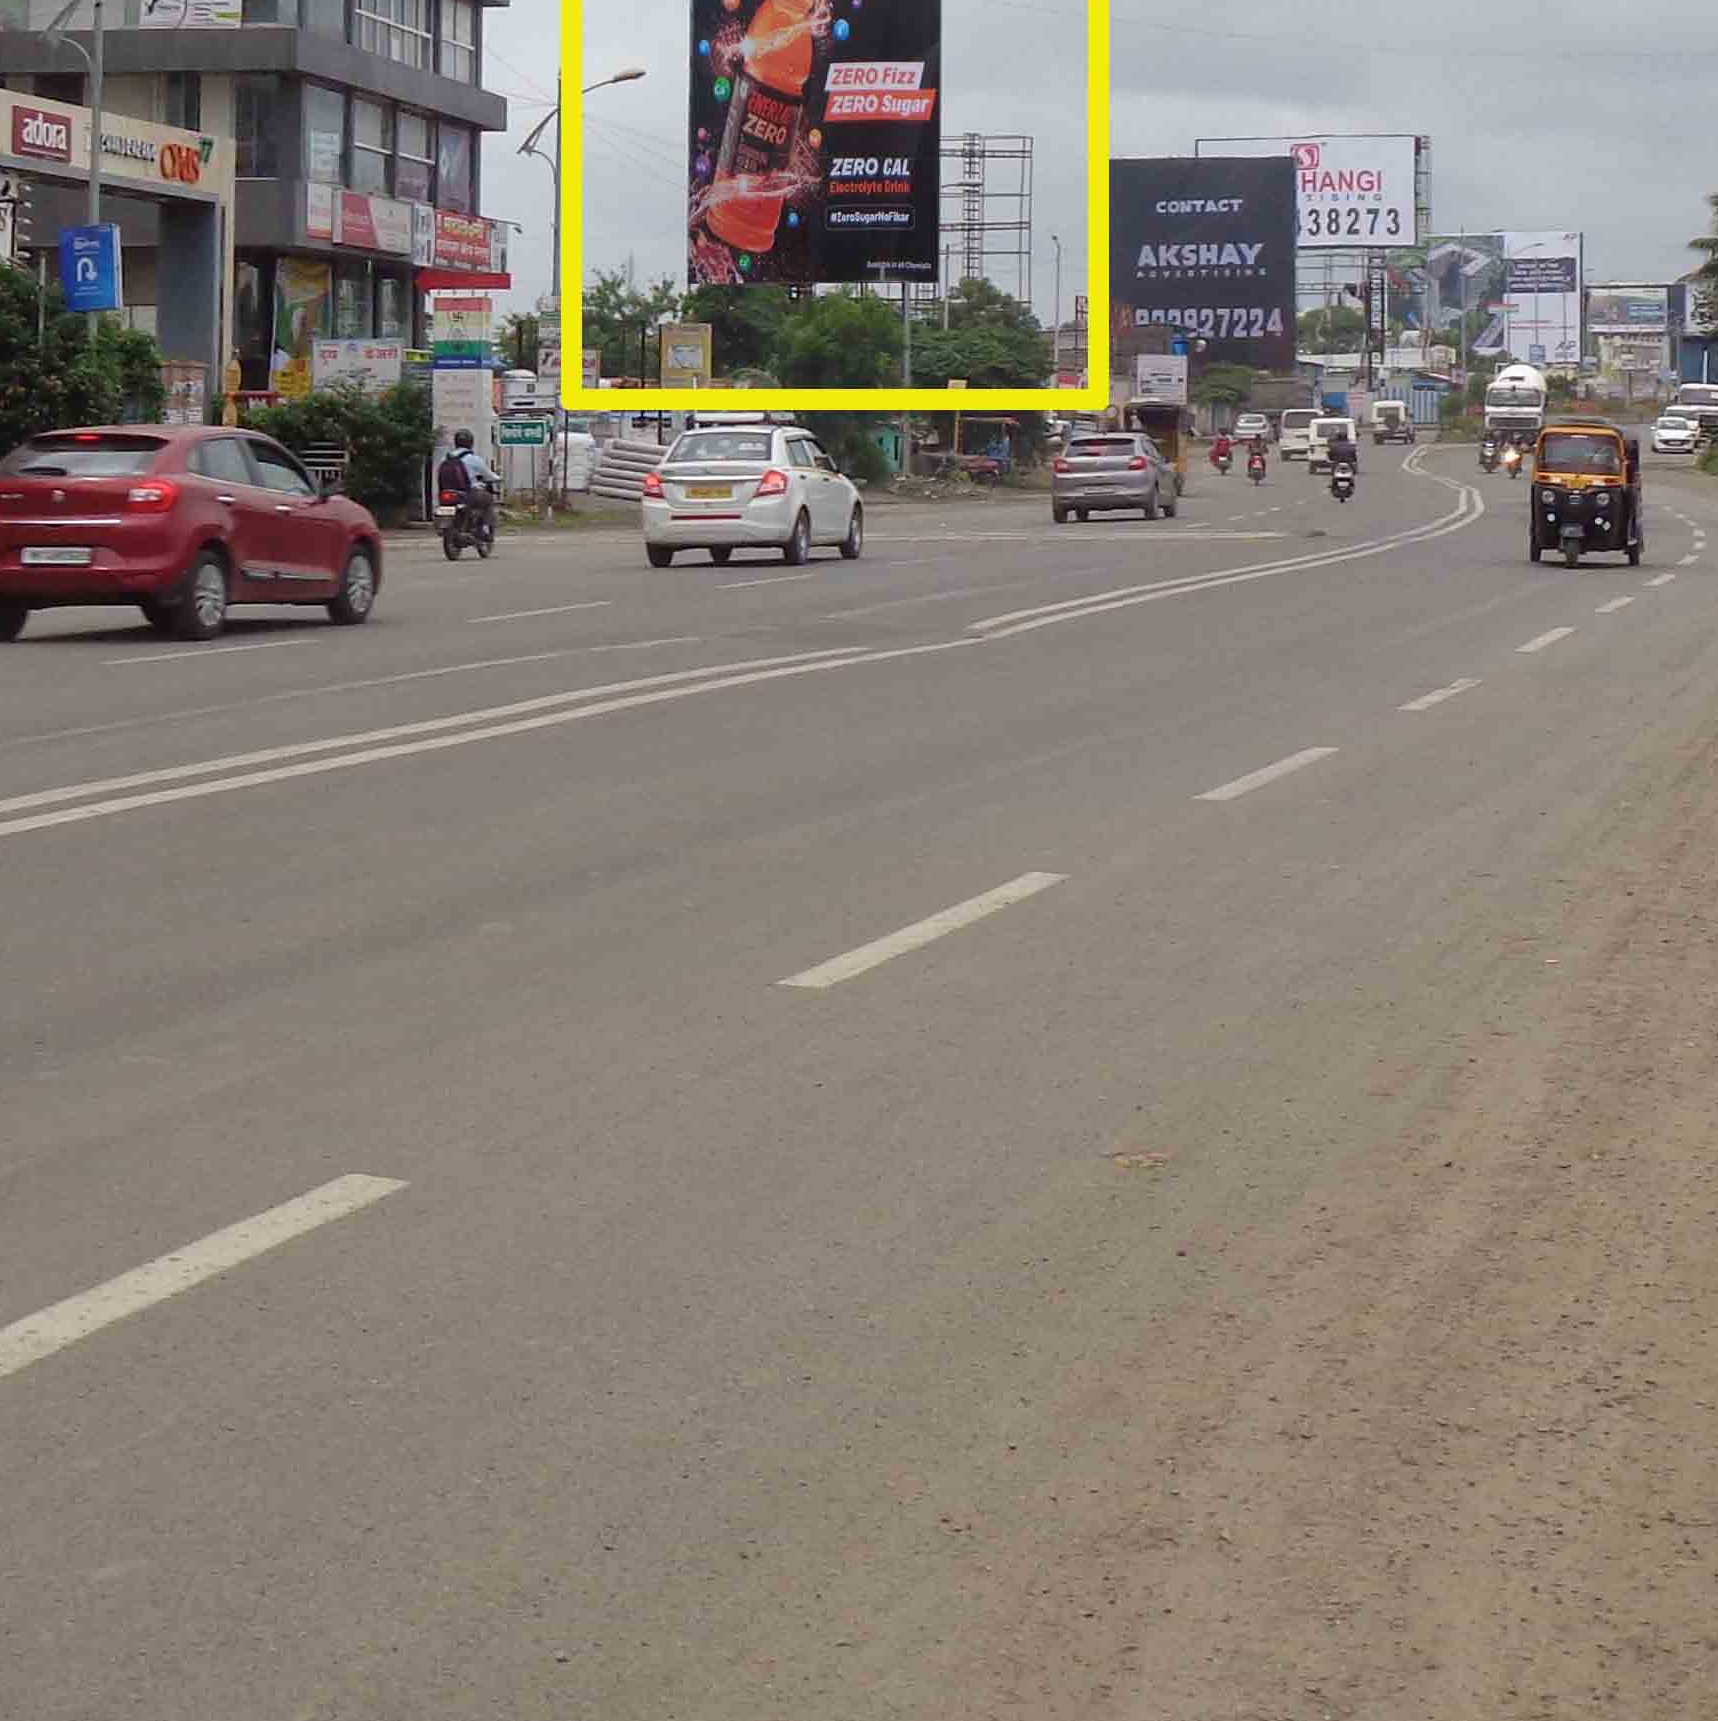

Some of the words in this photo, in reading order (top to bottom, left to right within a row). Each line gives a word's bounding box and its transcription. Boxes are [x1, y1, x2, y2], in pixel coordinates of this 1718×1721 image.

[831, 67, 878, 85] ZERO
[882, 67, 916, 84] Fizz
[830, 94, 879, 113] ZERO
[881, 94, 930, 116] Sugar
[21, 112, 68, 151] adora
[742, 113, 788, 146] ZERO
[829, 157, 879, 176] ZERO
[883, 157, 910, 176] CAL
[829, 181, 883, 196] Electrolyte
[884, 181, 910, 193] Drink
[1156, 198, 1244, 214] CONTACT
[1297, 207, 1401, 237] 38273
[1137, 242, 1266, 267] AKSHAY
